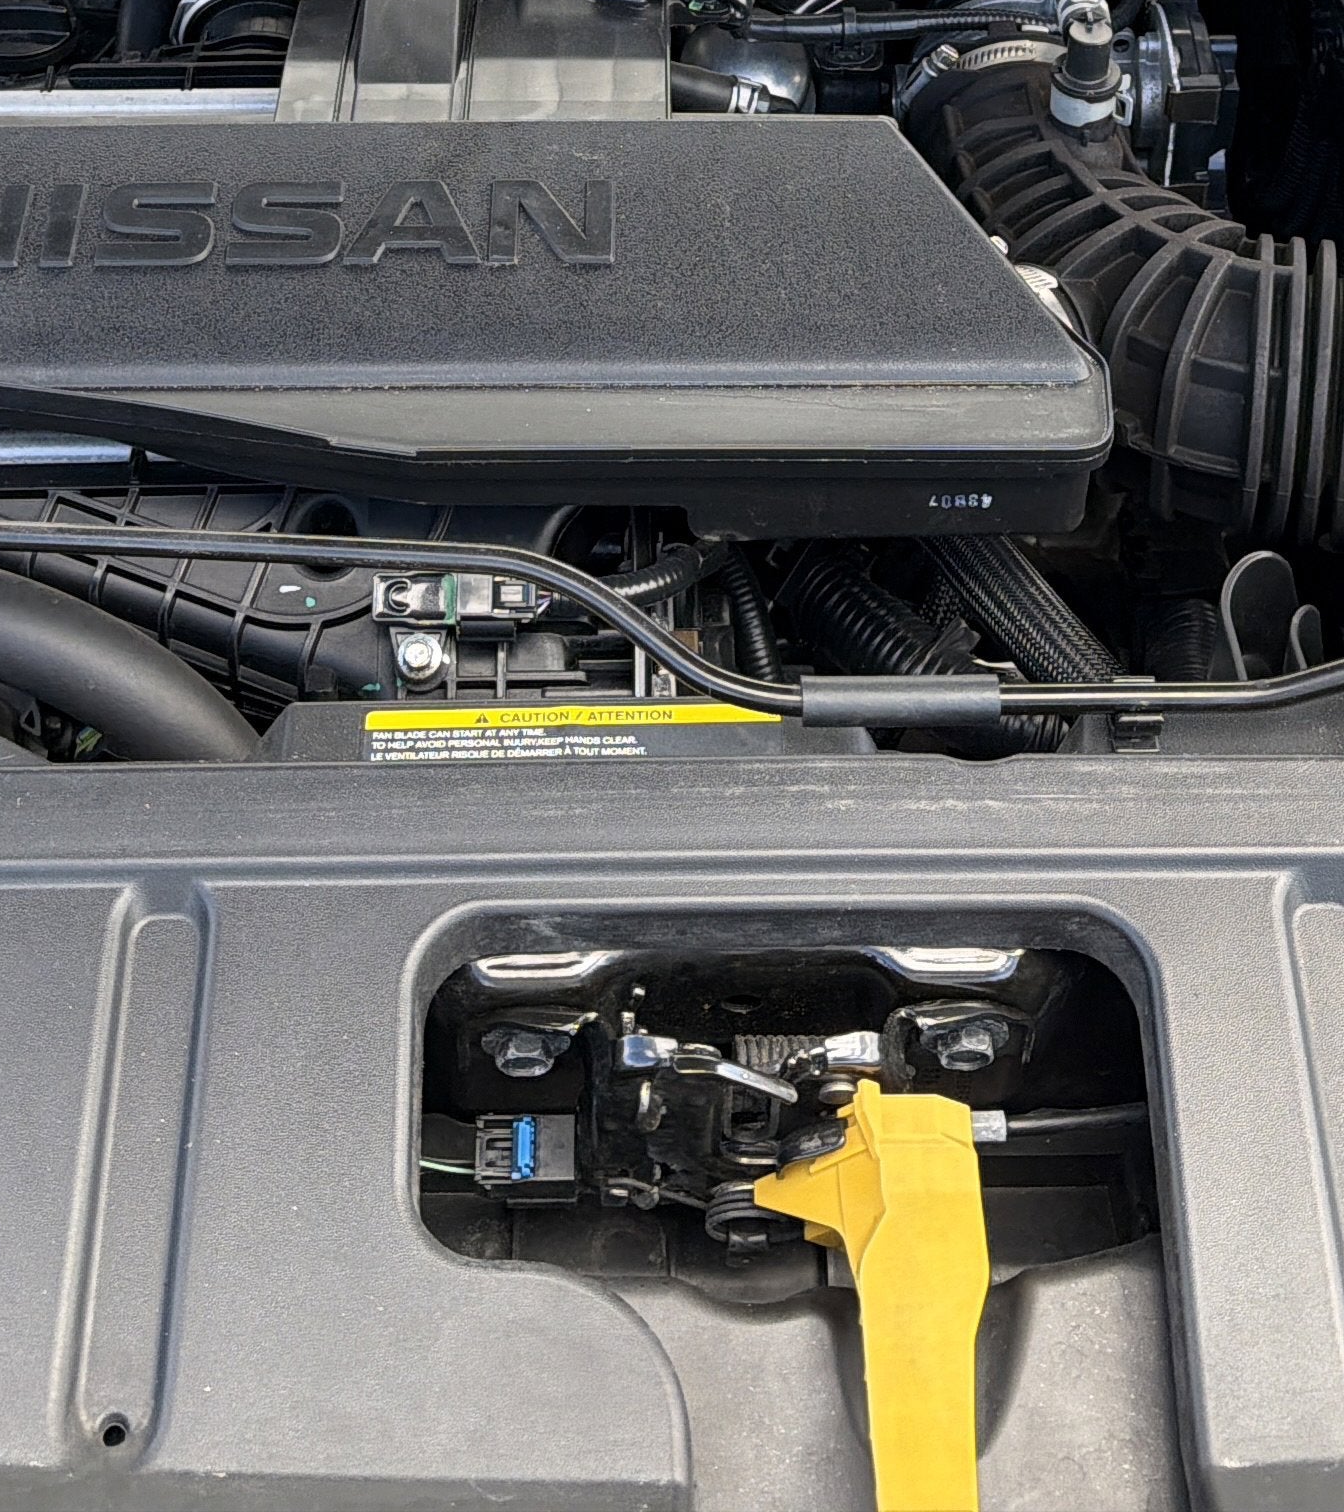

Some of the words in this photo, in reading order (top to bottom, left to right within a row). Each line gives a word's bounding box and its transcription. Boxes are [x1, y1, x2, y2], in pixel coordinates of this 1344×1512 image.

[500, 711, 570, 723] CAUTION
[587, 709, 673, 722] ATTENTION
[372, 731, 392, 740] FAN
[394, 731, 426, 739] BLADE
[429, 730, 451, 738] CAN
[453, 729, 482, 738] START
[484, 729, 496, 737] AT
[499, 729, 520, 737] ANY
[371, 741, 386, 750] TO
[388, 740, 414, 749] HELP
[415, 740, 446, 749] AVOID
[448, 738, 501, 748] PERSONAL
[565, 736, 601, 745] HANDS
[602, 735, 638, 745] CLEAR.
[370, 752, 383, 761] LE
[385, 750, 450, 761] VENTILATEUR
[451, 749, 489, 760] RISQUE
[491, 749, 505, 758] DE
[507, 746, 563, 758] DÉMARRER
[573, 746, 600, 756] TOUT
[601, 746, 647, 756] MOMENT.
